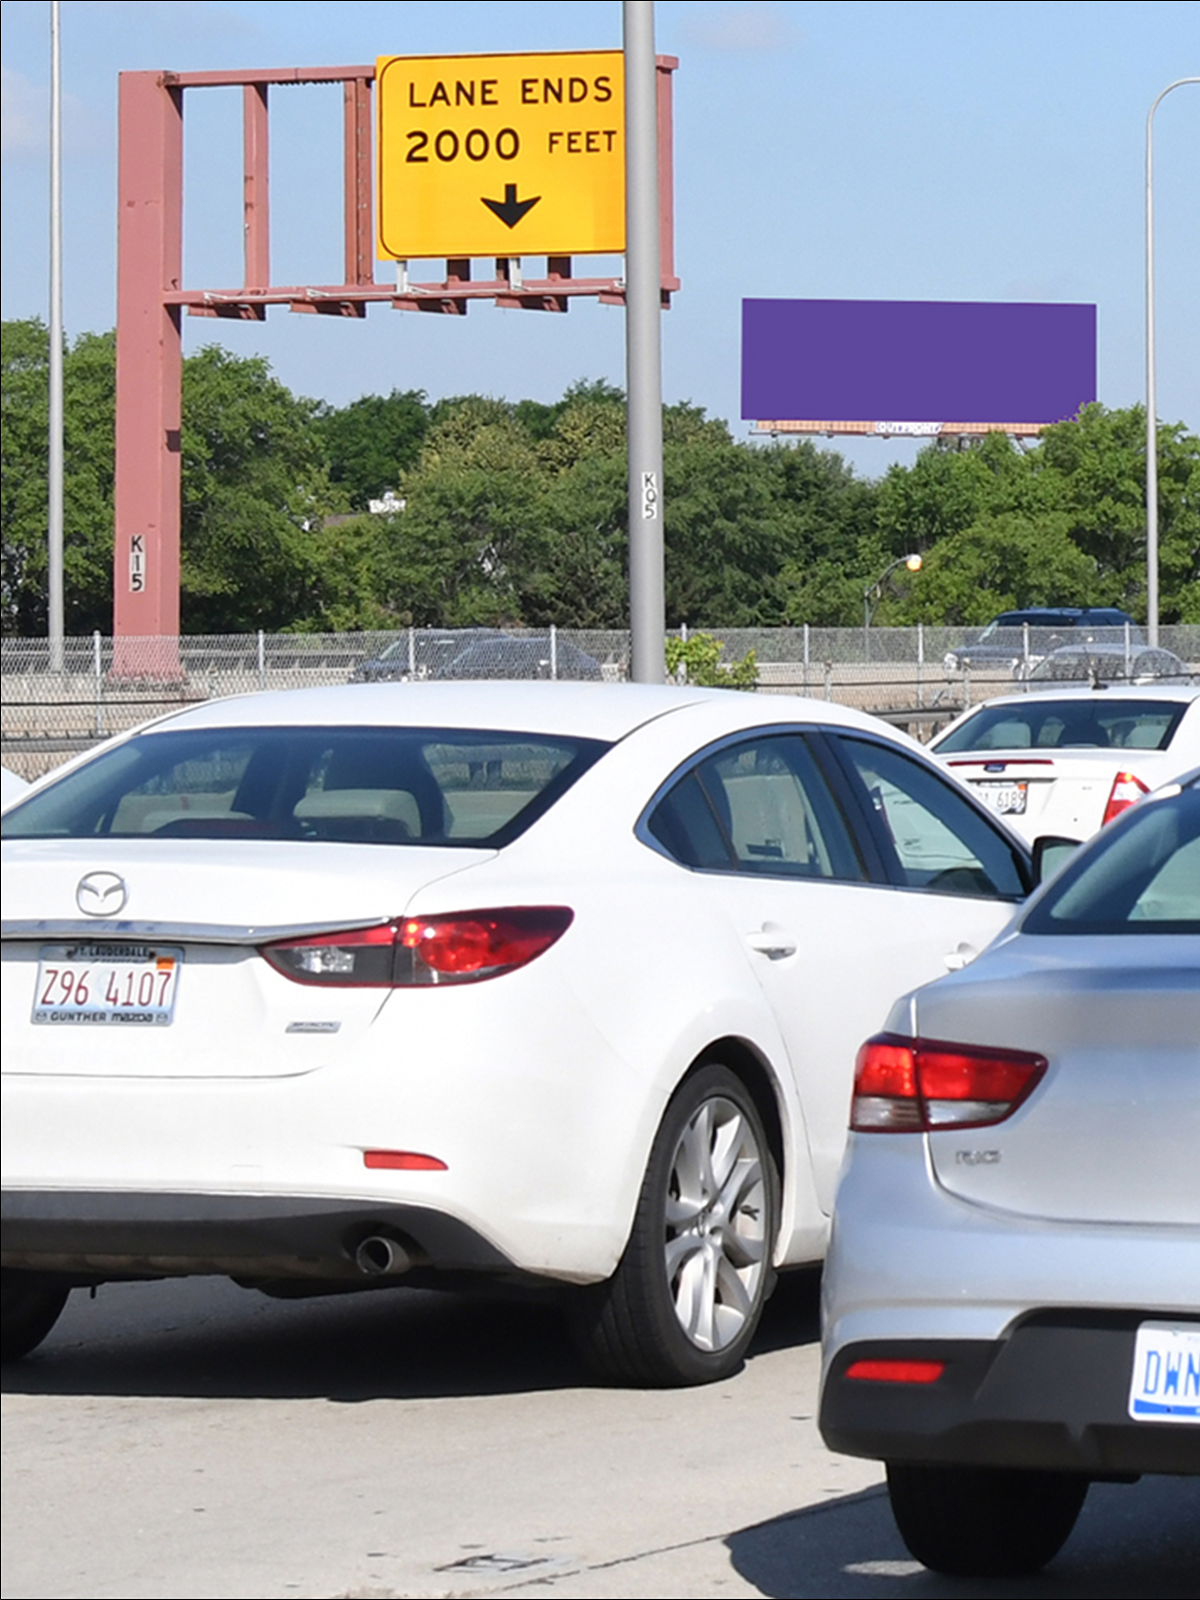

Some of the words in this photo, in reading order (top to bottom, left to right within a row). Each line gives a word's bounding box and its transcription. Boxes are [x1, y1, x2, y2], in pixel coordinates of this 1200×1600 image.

[409, 80, 499, 108] LANE
[521, 76, 613, 104] ENDS
[405, 127, 520, 163] 2000
[548, 130, 617, 153] FEET
[131, 535, 143, 592] K15
[89, 946, 148, 957] LAUDERDALE
[41, 970, 90, 1006] Z96
[105, 971, 172, 1007] 4107
[50, 1011, 106, 1021] GUNTHER
